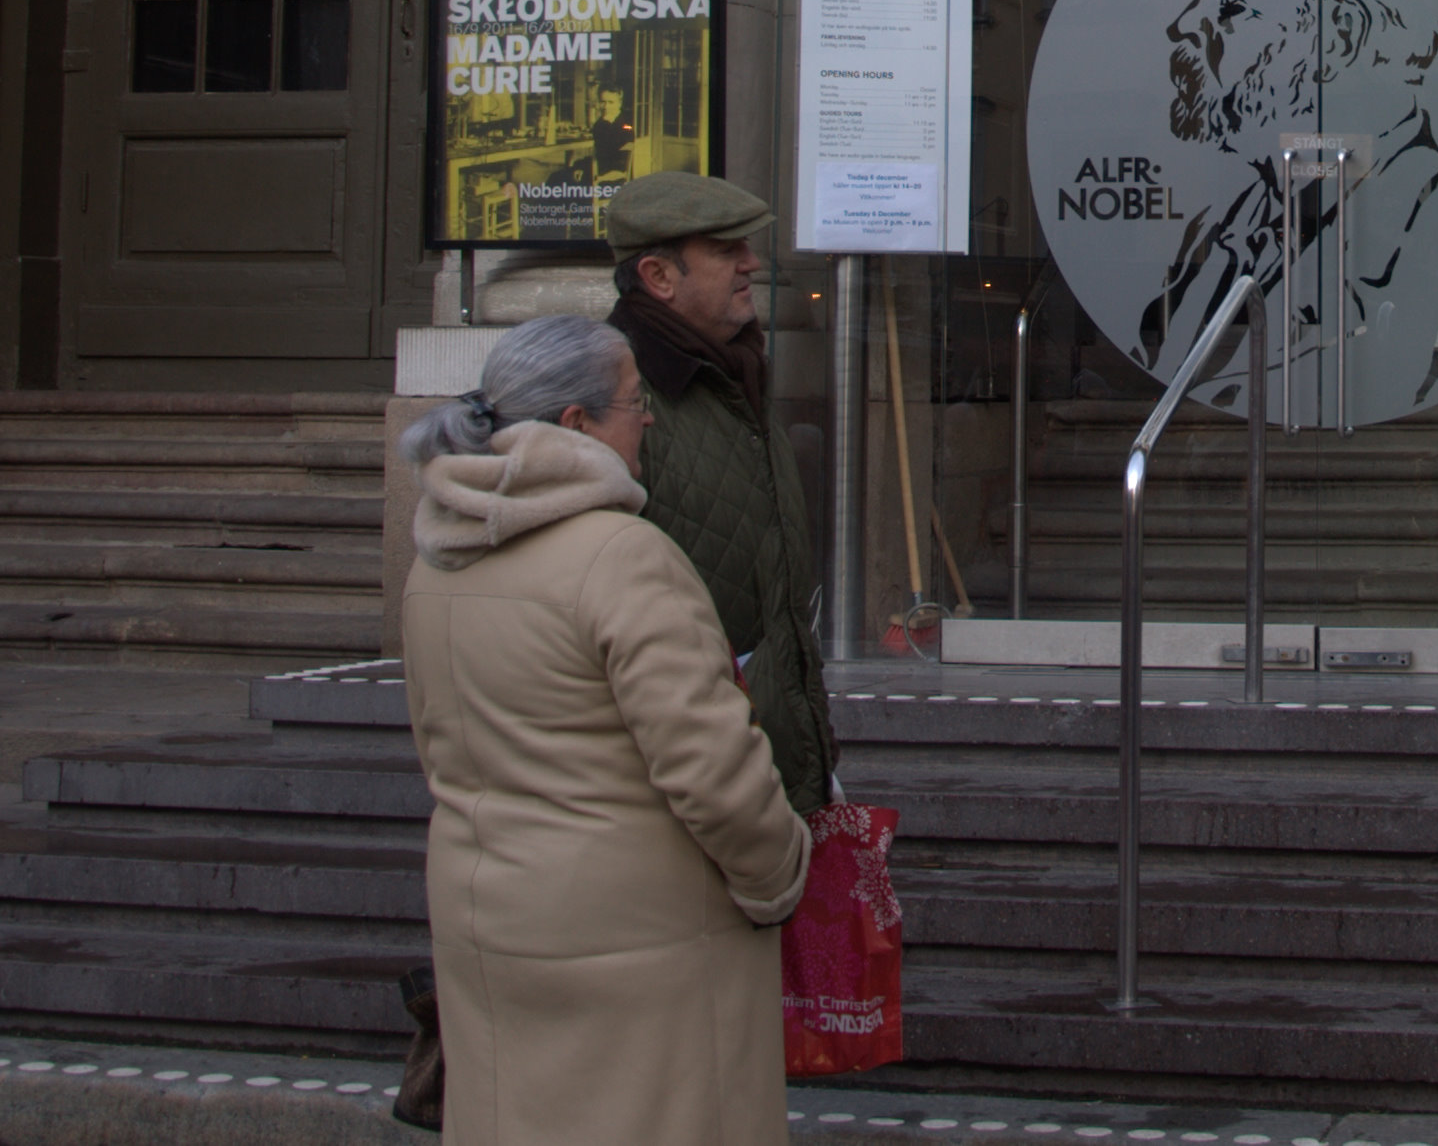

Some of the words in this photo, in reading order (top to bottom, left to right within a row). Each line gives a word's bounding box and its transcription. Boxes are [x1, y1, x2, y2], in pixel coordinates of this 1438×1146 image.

[558, 20, 592, 33] 2012
[446, 32, 612, 64] MADAME
[447, 65, 552, 96] CURIE
[820, 70, 860, 78] OPENING
[862, 71, 894, 79] HOURS
[1291, 165, 1338, 177] CLOSE
[1058, 187, 1184, 220] NOBEL
